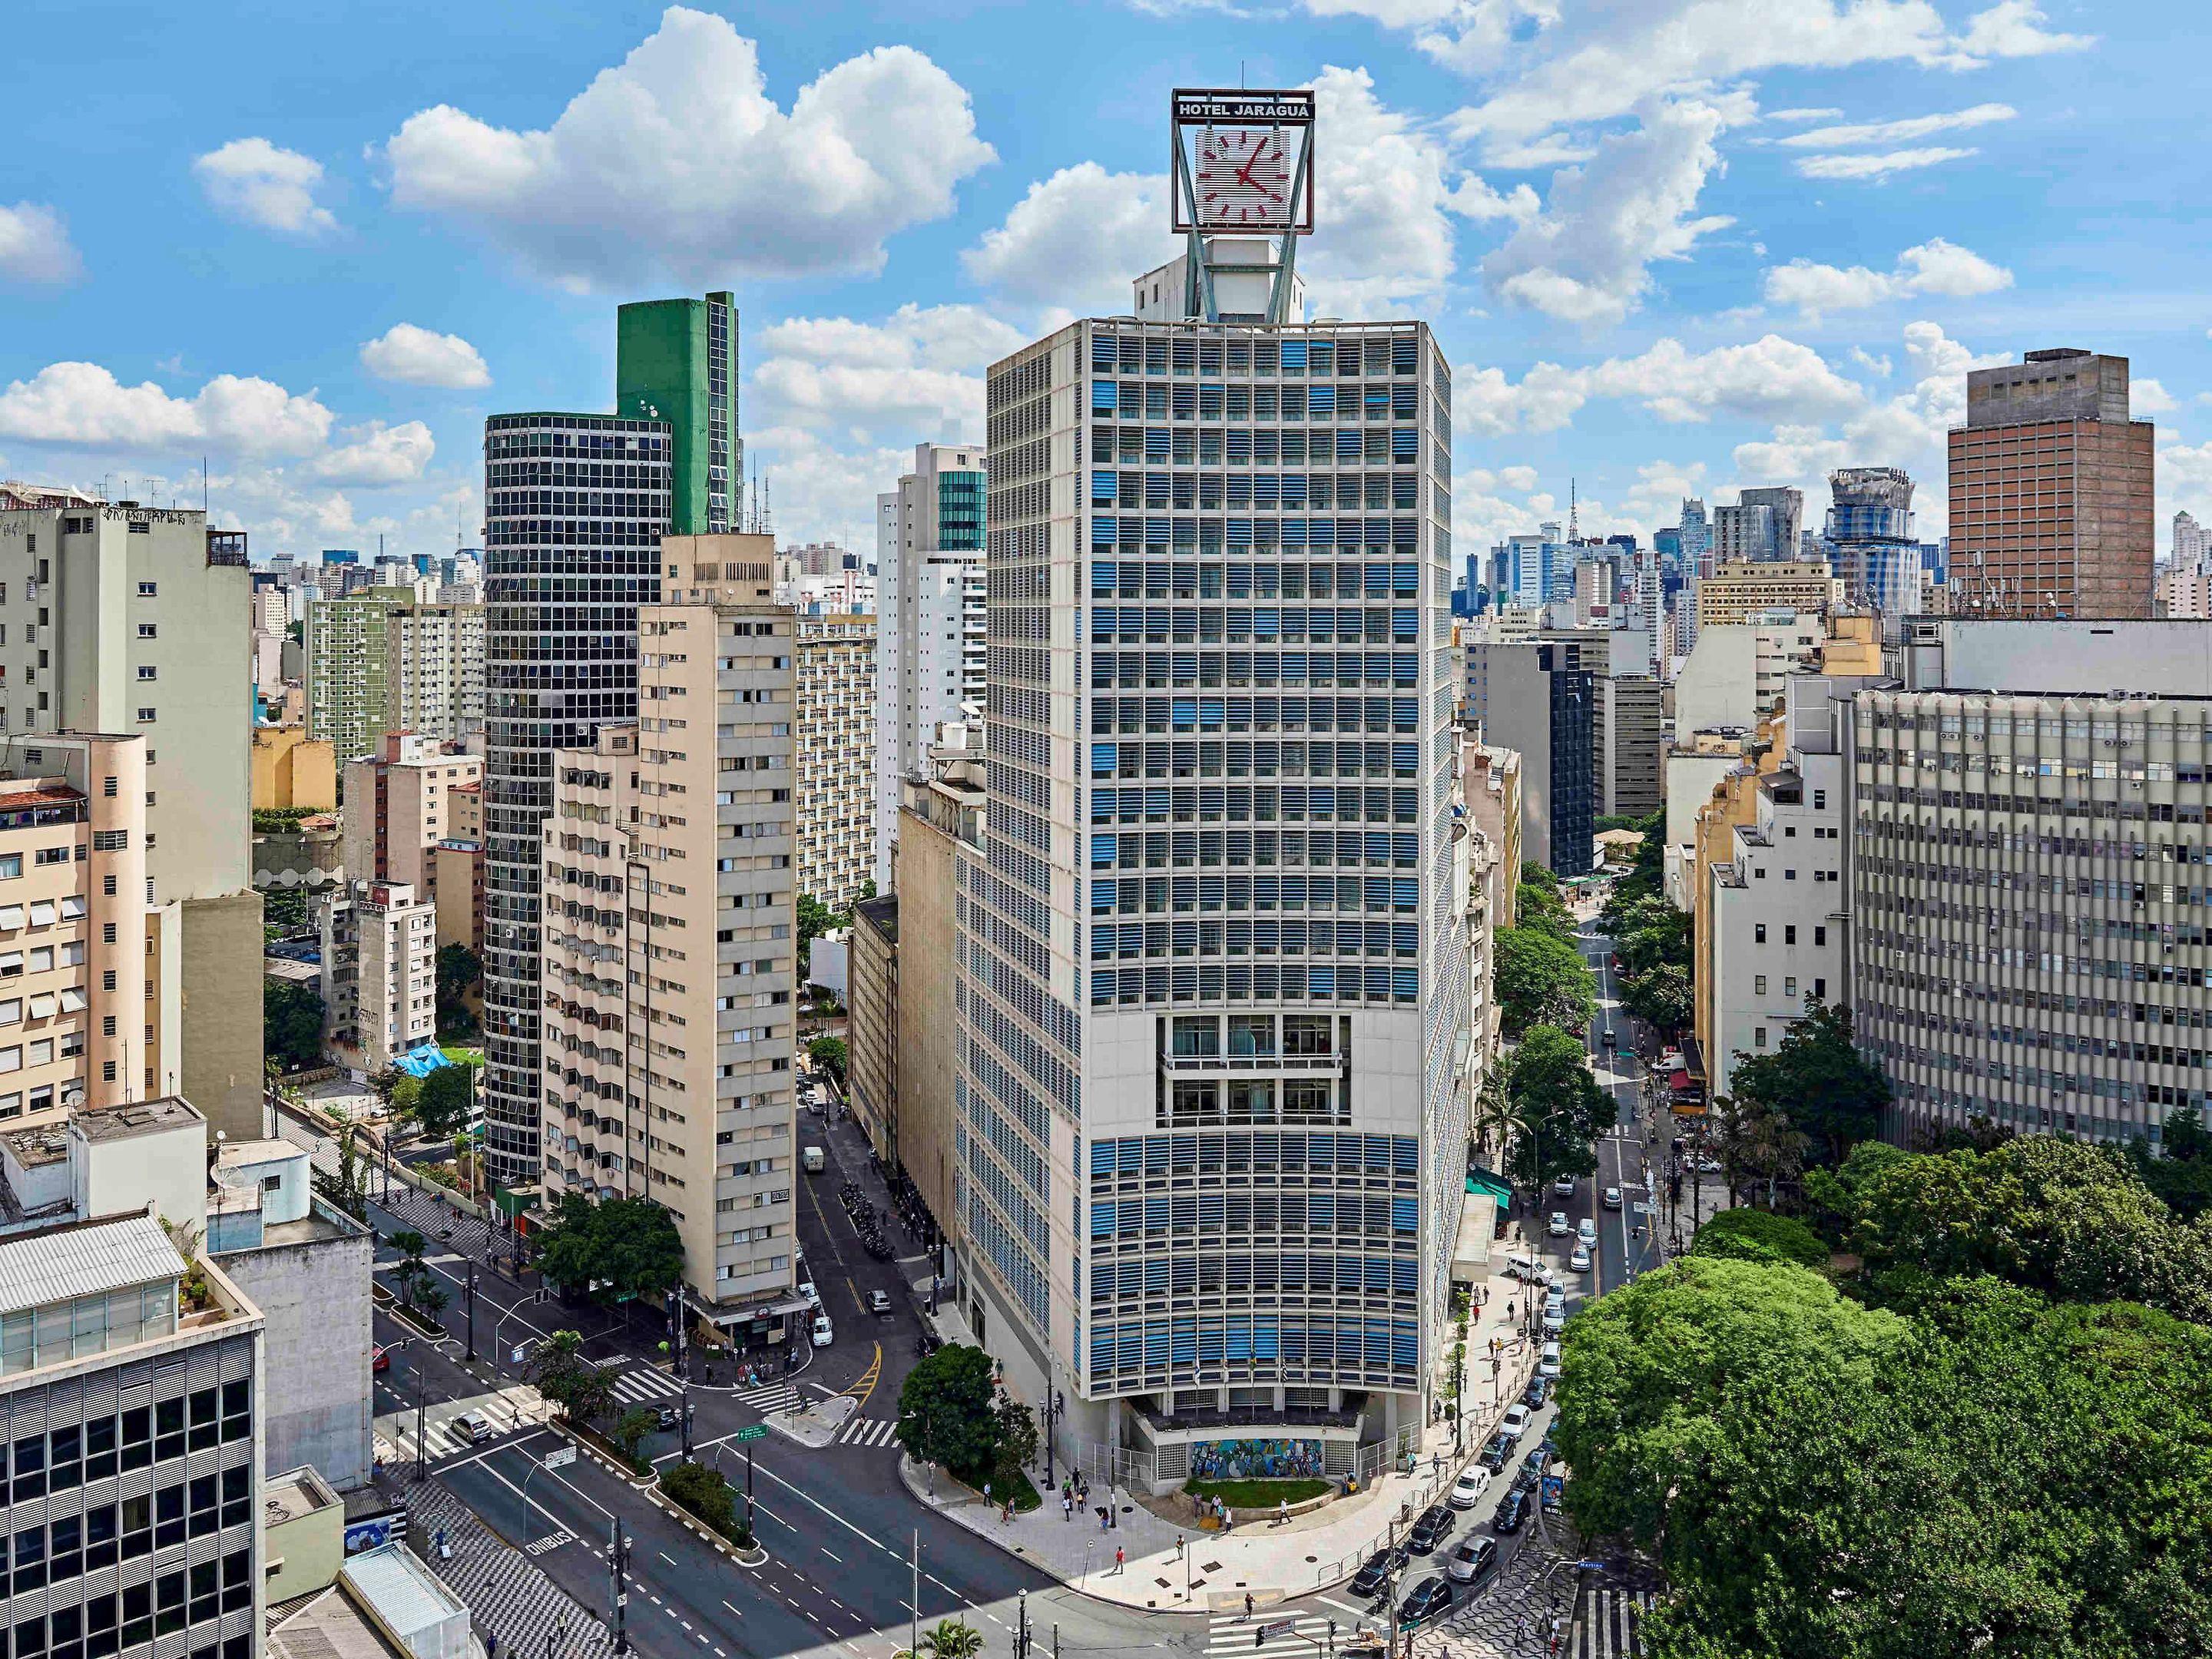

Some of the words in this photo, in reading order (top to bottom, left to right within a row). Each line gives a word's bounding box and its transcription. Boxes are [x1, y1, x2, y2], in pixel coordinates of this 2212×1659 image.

[1179, 104, 1230, 115] HOTEL
[1234, 104, 1309, 116] JARAGUÁ
[525, 1531, 573, 1556] ONIBUS
